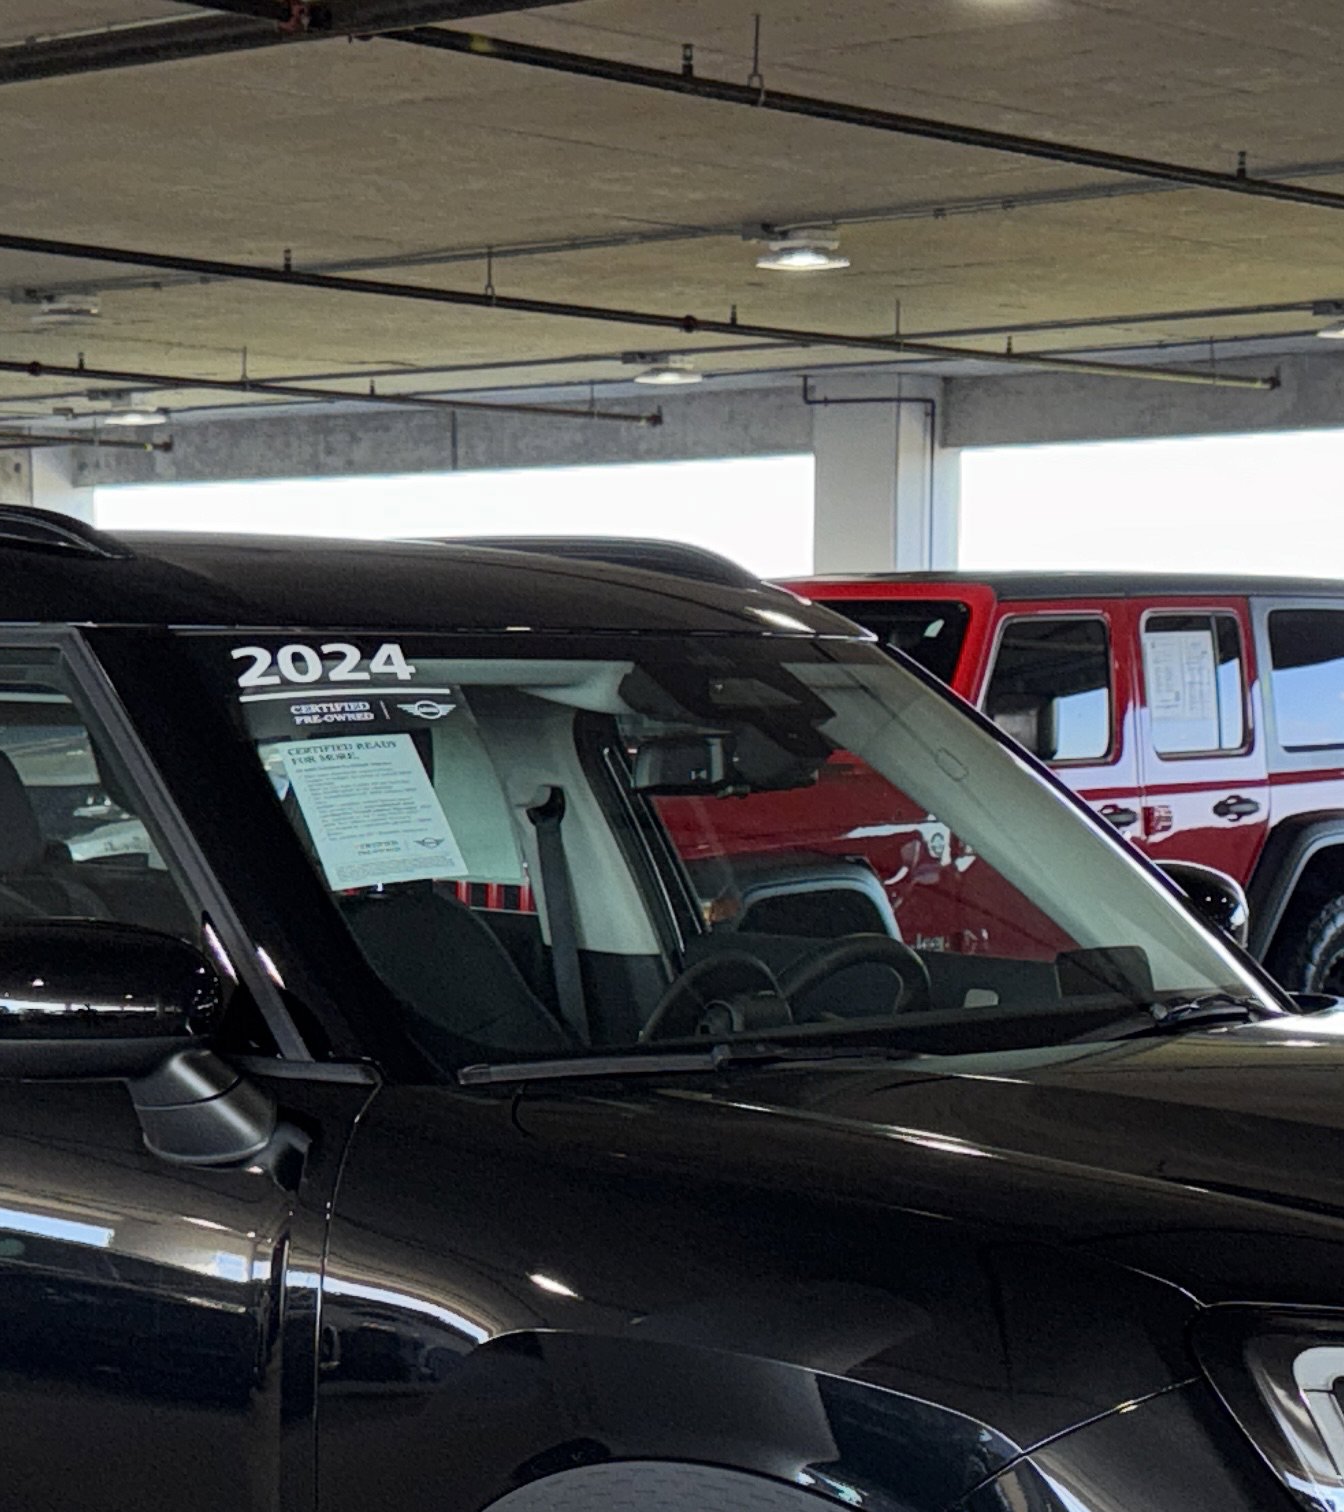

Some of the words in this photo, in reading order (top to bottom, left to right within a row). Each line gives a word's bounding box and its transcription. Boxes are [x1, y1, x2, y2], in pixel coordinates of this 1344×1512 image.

[231, 643, 416, 687] 2024
[290, 702, 370, 715] CERTIFIED
[294, 712, 375, 725] PRE-OWNED
